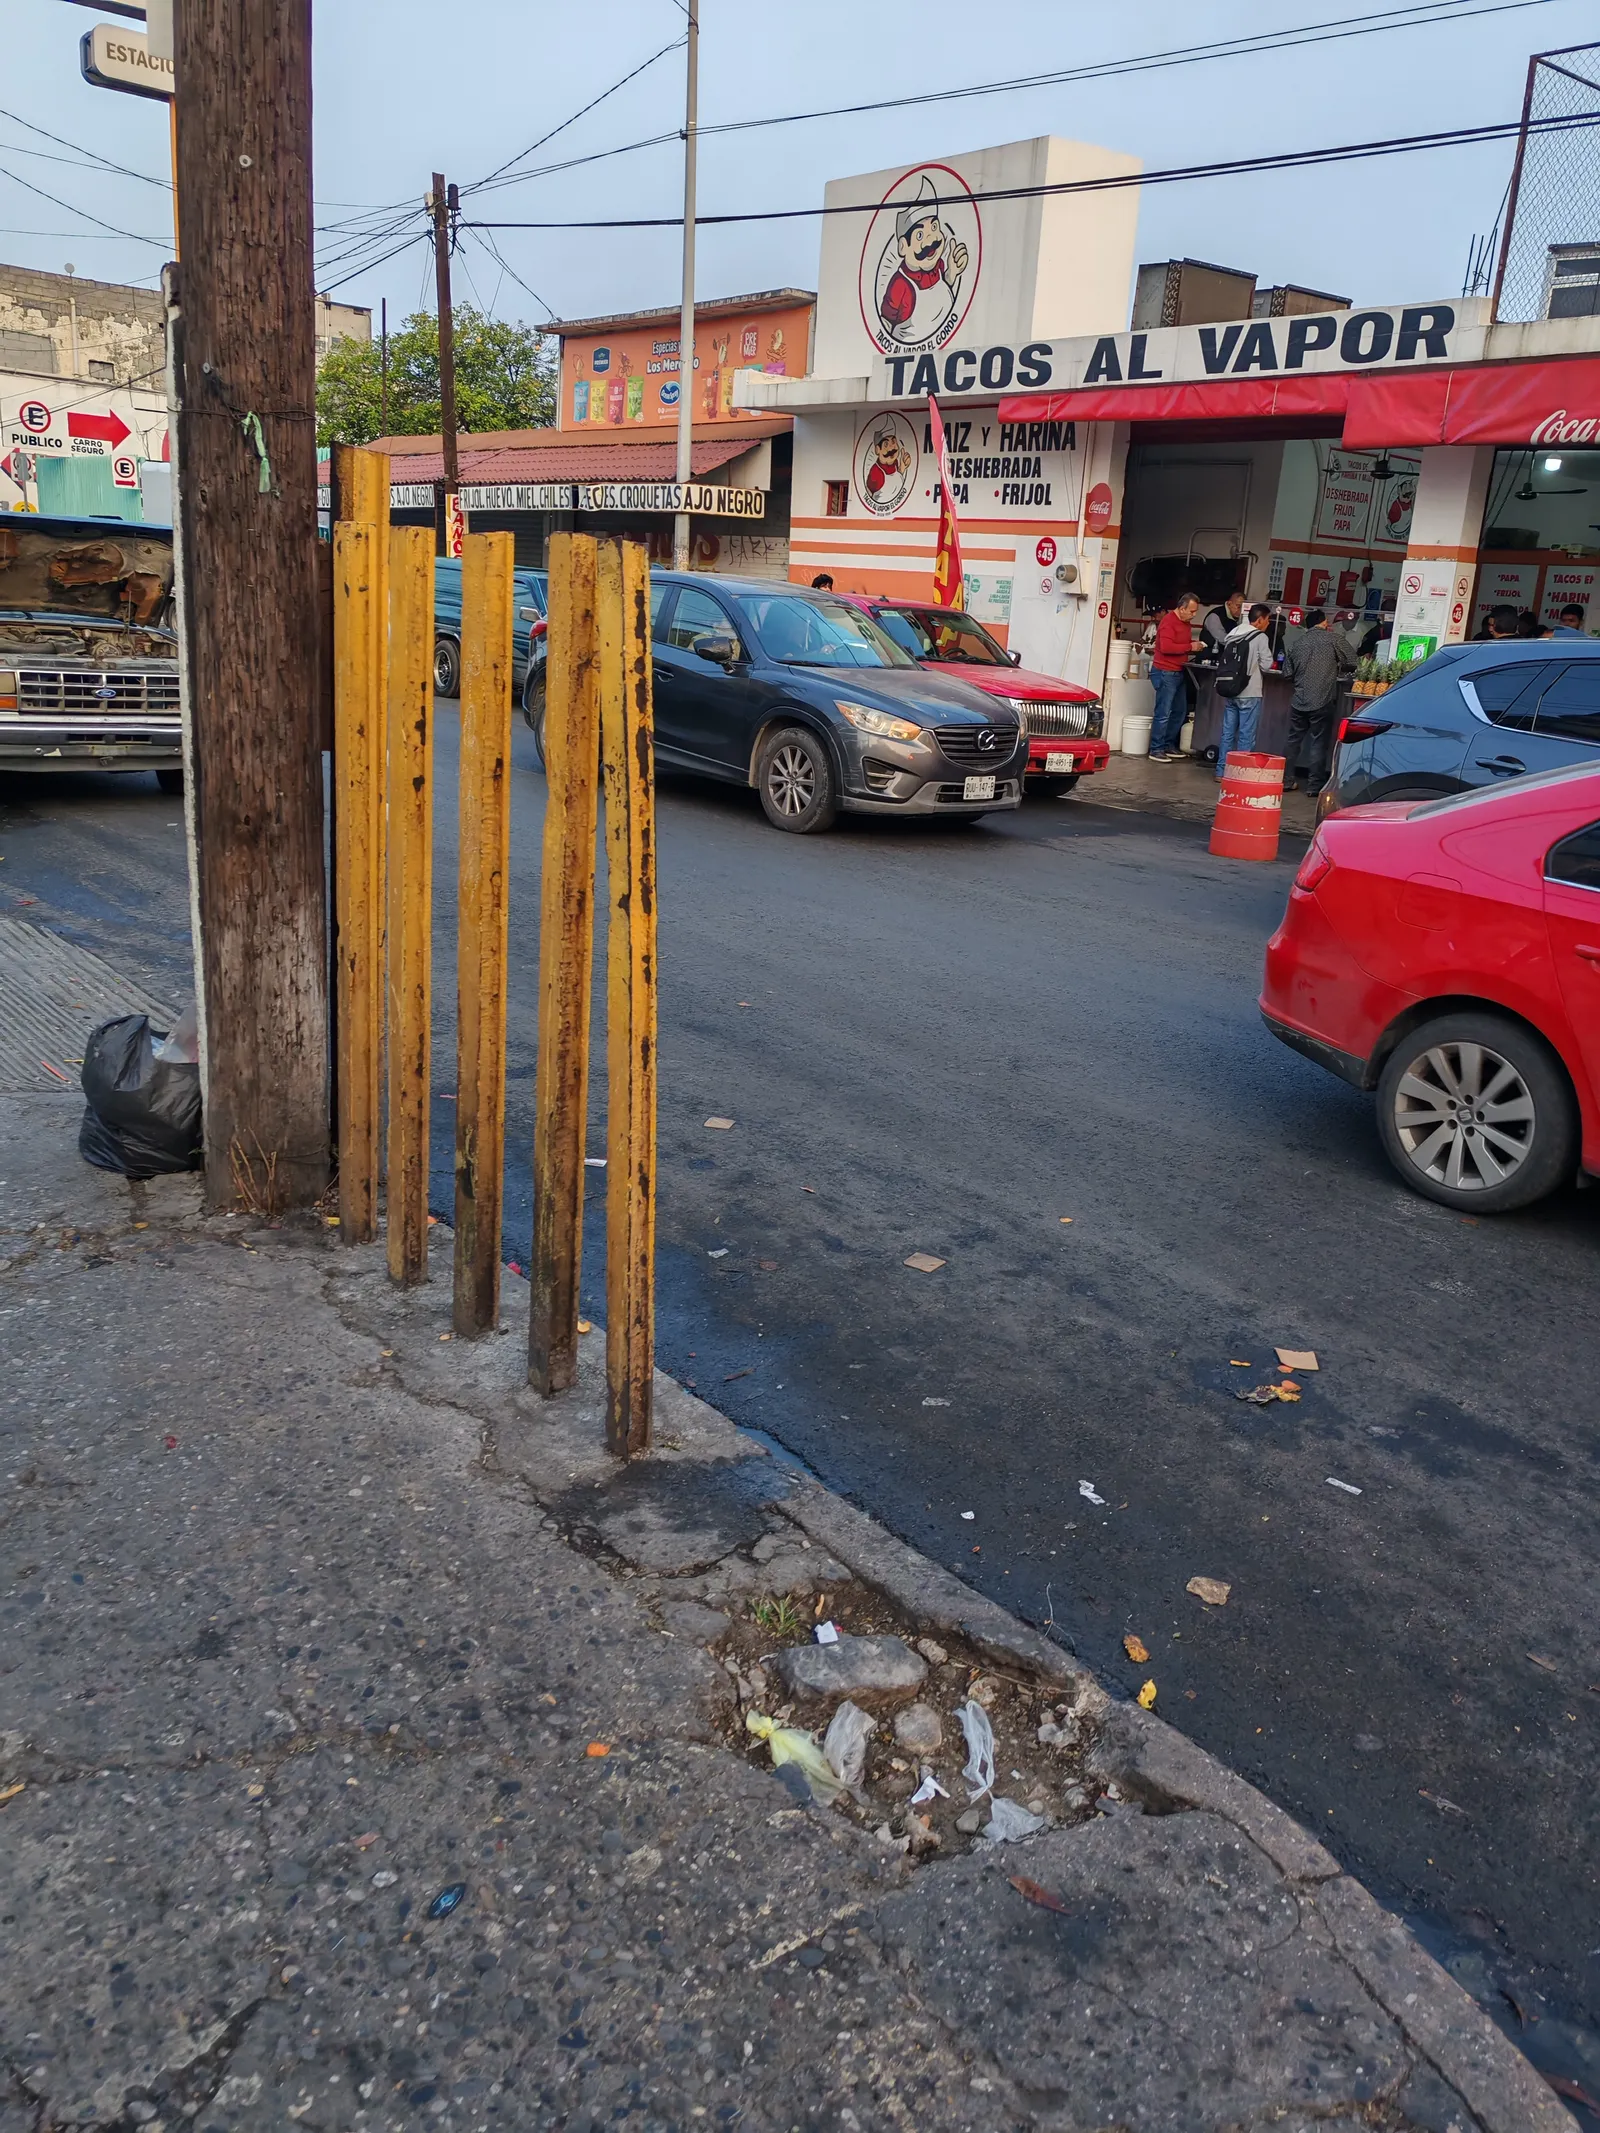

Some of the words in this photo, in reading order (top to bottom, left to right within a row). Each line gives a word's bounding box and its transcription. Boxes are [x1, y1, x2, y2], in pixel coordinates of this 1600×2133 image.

[935, 313, 959, 346] GORDO
[884, 342, 1054, 397] TACOS
[1083, 333, 1163, 384] AL
[1198, 304, 1456, 375] VAPOR
[646, 360, 661, 374] Los
[12, 433, 63, 449] PUBLICO
[73, 438, 103, 448] CARRO
[981, 426, 991, 447] Y
[999, 421, 1076, 452] HARINA
[71, 445, 104, 456] SEGURO
[397, 486, 410, 507] AJO
[411, 485, 434, 507] NEGRO
[620, 485, 682, 511] CROQUETAS
[684, 486, 713, 512] AJO
[717, 488, 763, 516] NEGRO
[933, 483, 969, 504] PPA
[1001, 482, 1052, 506] FRIJOL
[1325, 487, 1369, 504] DESHEBRADA
[1333, 503, 1356, 517] FRIJOL
[1333, 519, 1351, 532] PAPA
[1037, 547, 1054, 562] $45
[1500, 574, 1520, 582] PAPA
[1553, 574, 1582, 585] TACOS
[1496, 589, 1522, 598] FRIJOL
